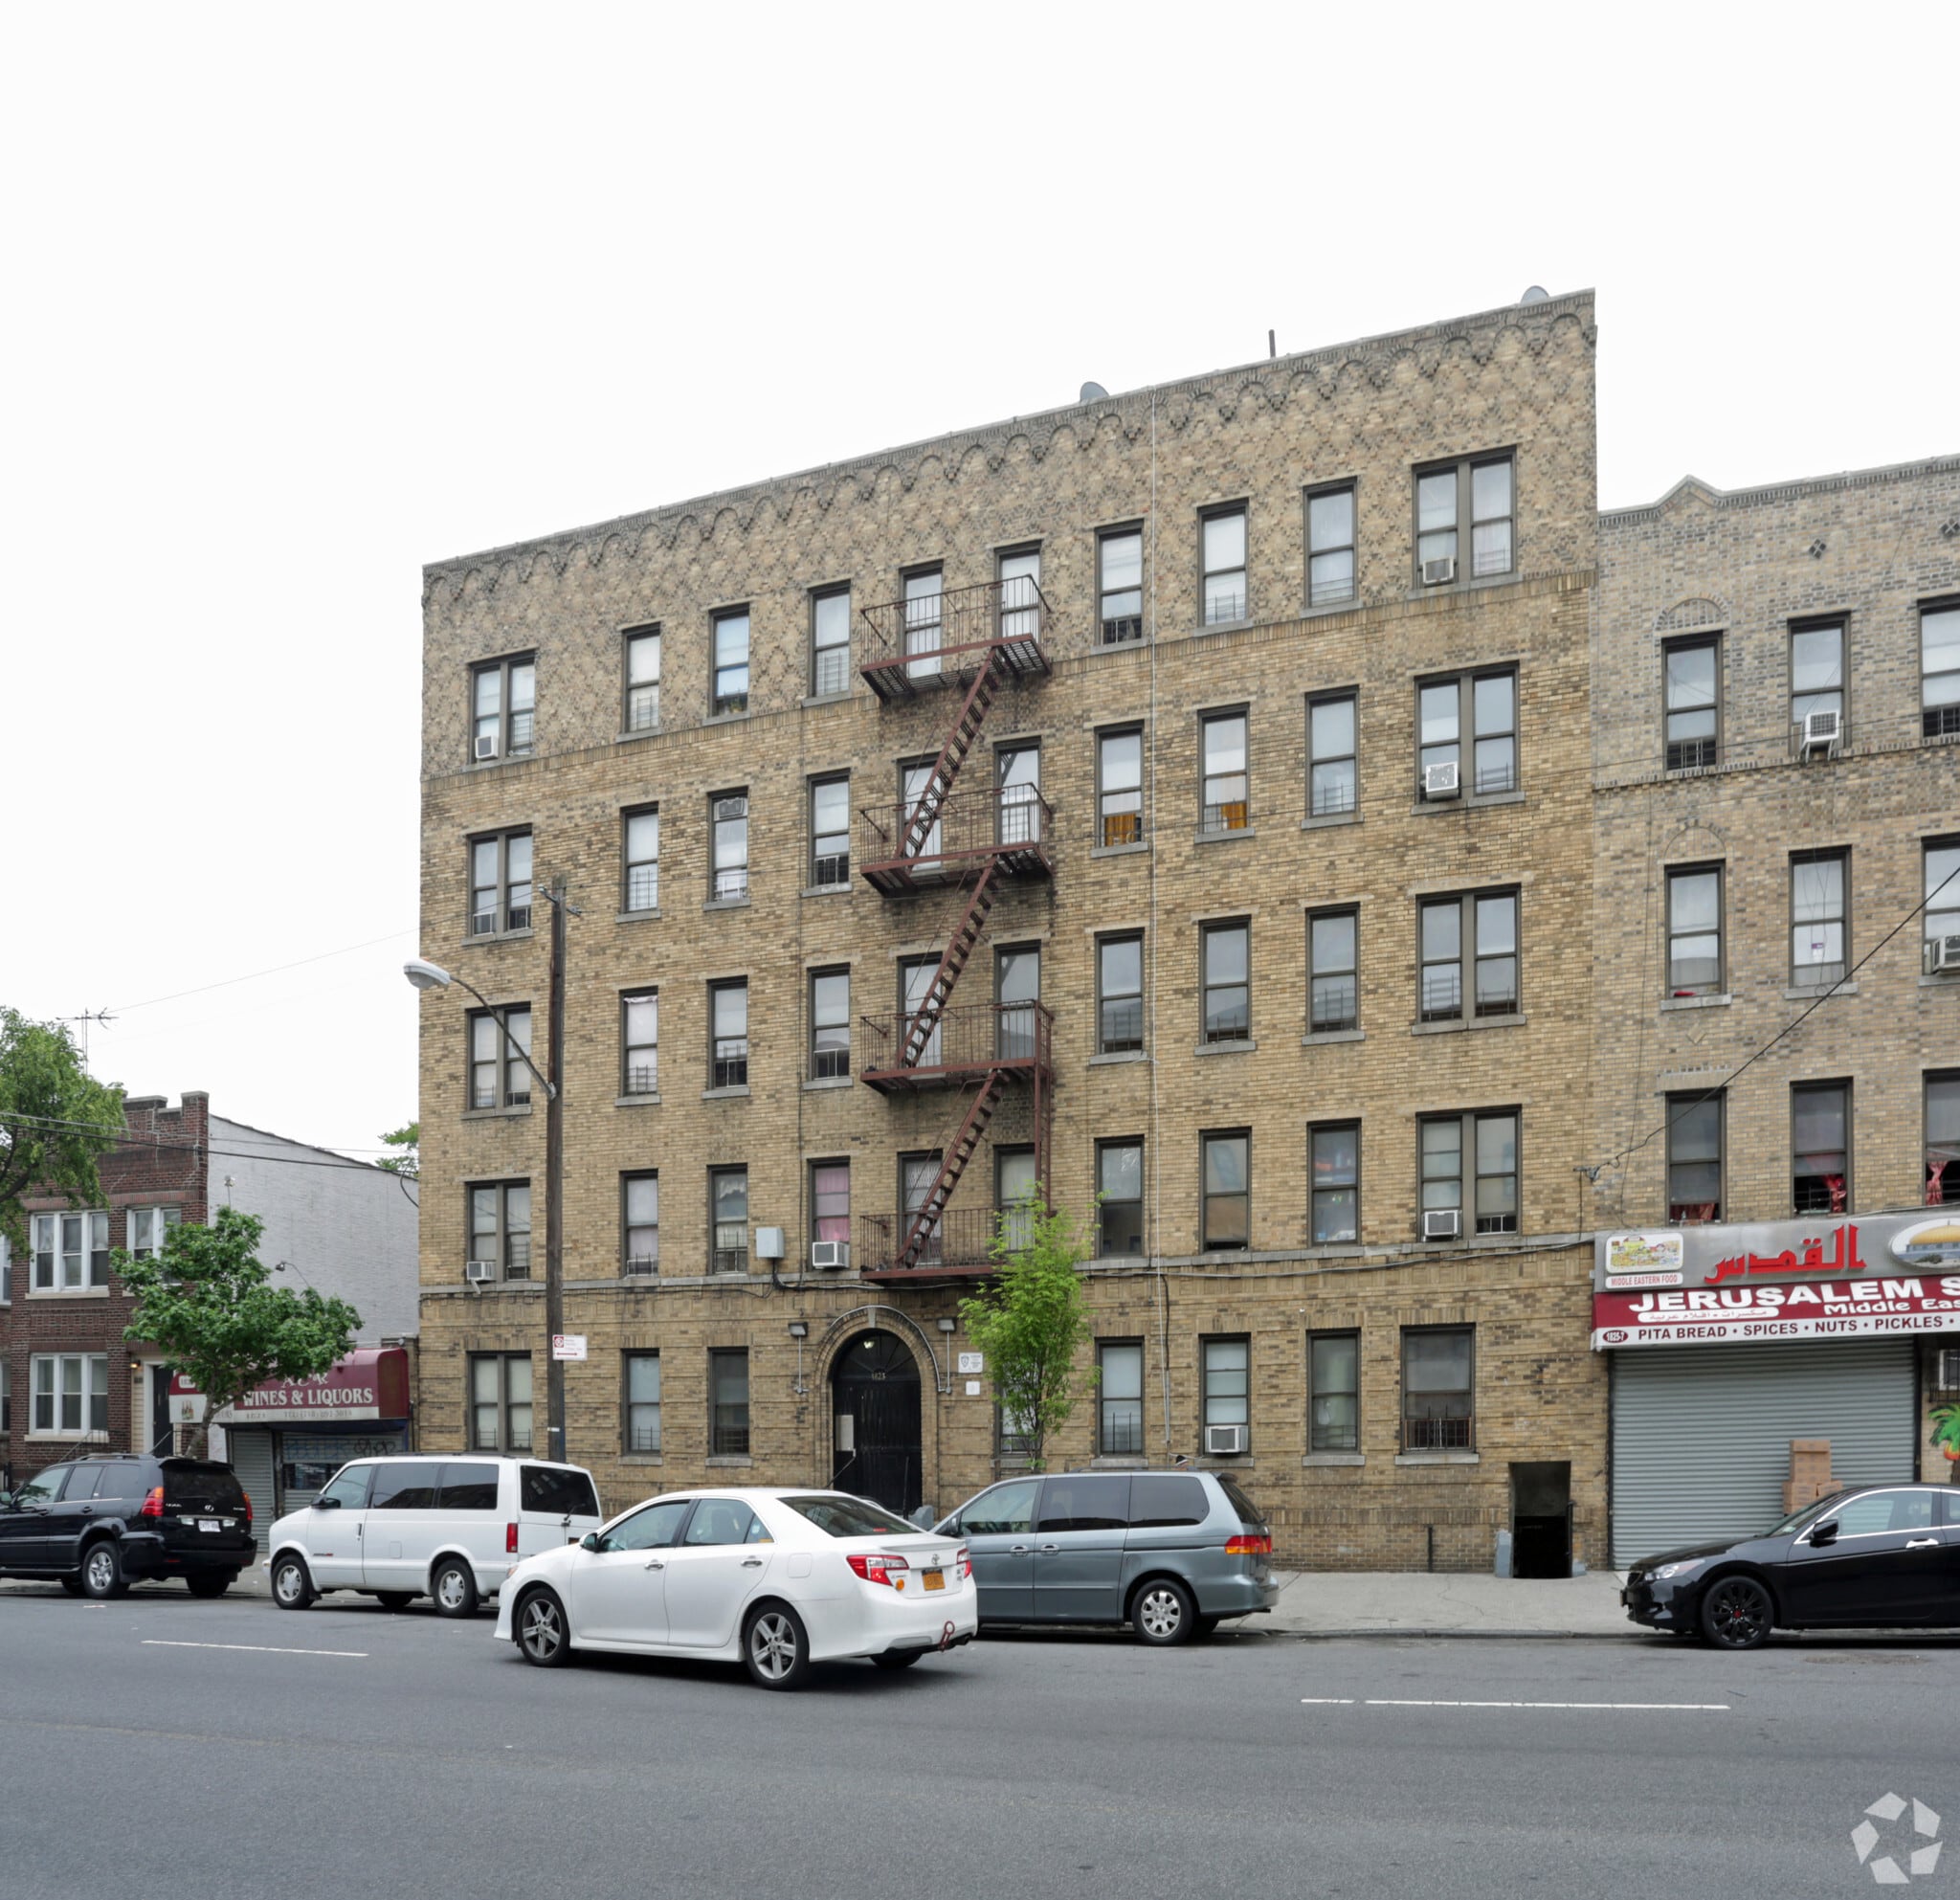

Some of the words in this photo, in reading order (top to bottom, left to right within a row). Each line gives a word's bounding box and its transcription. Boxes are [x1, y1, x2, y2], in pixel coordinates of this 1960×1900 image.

[1704, 1223, 1867, 1285] القدس
[1611, 1277, 1633, 1286] MIDDLE
[1634, 1276, 1660, 1285] EASTERN
[1661, 1274, 1678, 1284] FOOD
[1629, 1279, 1925, 1312] JERUSALEM
[1824, 1300, 1911, 1315] Middle
[1638, 1328, 1671, 1340] PITA
[1677, 1326, 1726, 1339] BREAD
[1744, 1323, 1798, 1336] SPICES
[1815, 1320, 1858, 1332] NUTS
[1875, 1316, 1943, 1330] PICKLES
[243, 1390, 287, 1406] WINES
[291, 1390, 303, 1405] &
[307, 1388, 373, 1406] LIQUORS
